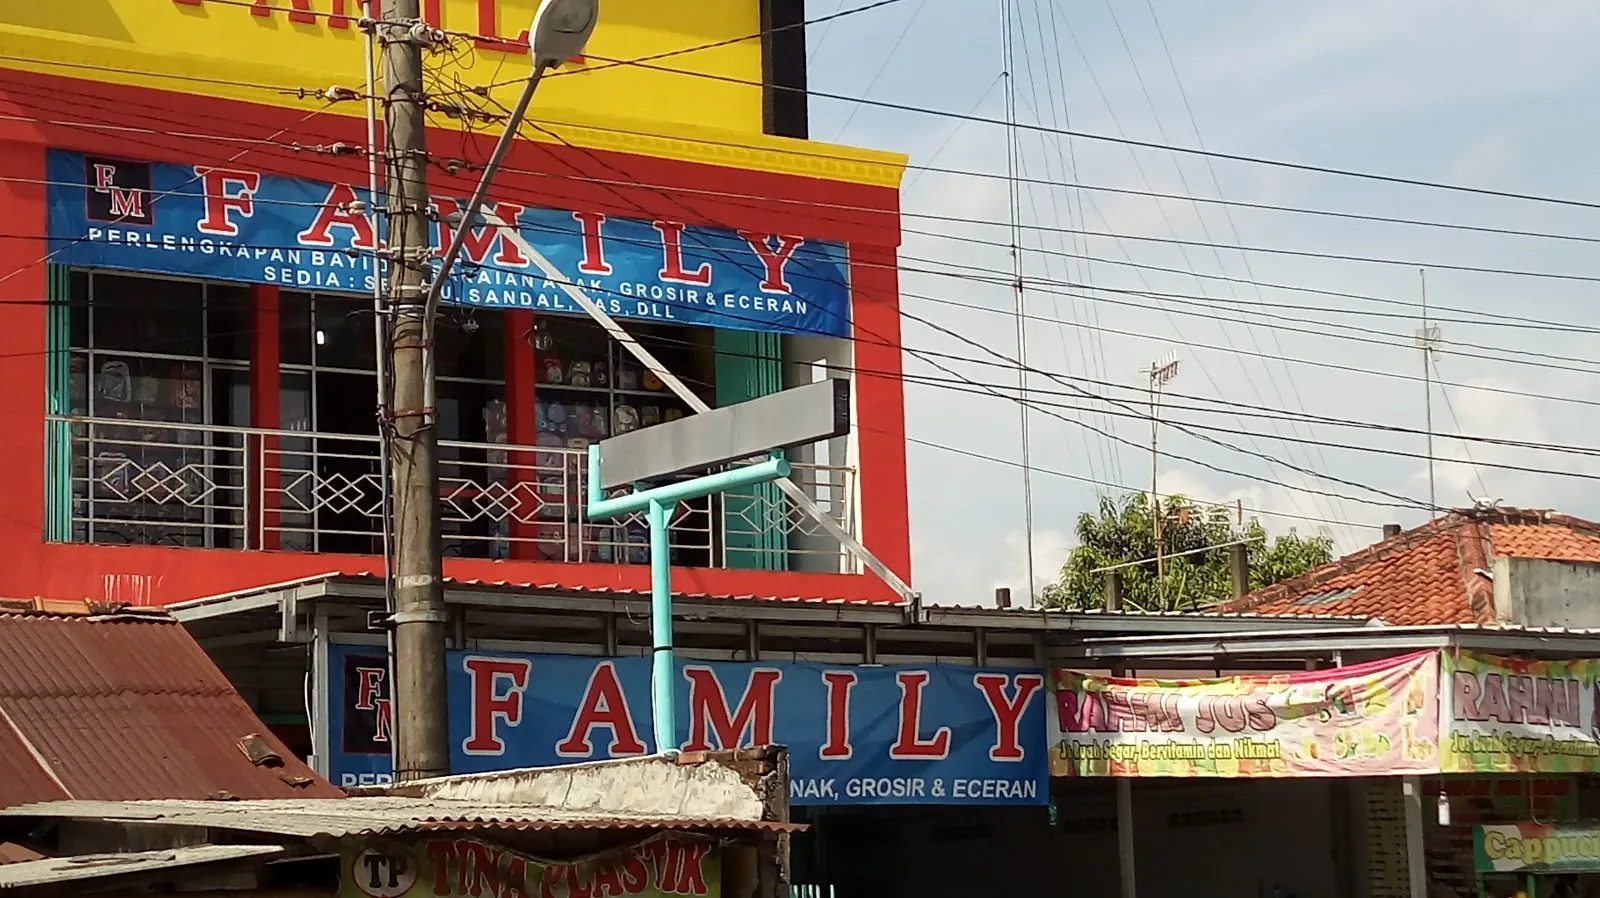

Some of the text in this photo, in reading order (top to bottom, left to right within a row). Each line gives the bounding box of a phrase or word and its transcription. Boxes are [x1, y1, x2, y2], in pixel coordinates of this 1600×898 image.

[193, 165, 804, 295] FAMILY
[89, 227, 301, 265] PERLENGKAPAN
[312, 250, 368, 270] BAYI
[542, 275, 612, 297] AAK,
[620, 283, 698, 304] GROSIR
[706, 292, 717, 306] &
[724, 294, 807, 315] ECERAN
[264, 267, 340, 287] SEDIA
[469, 288, 573, 311] SANDAL,
[588, 298, 629, 316] AS,
[637, 302, 675, 318] DLL
[462, 656, 1044, 763] FAMILY
[1196, 692, 1276, 733] JUS
[1141, 738, 1205, 760] Bervitamin
[1207, 737, 1232, 760] dan
[1234, 737, 1281, 760] Nikmat
[790, 778, 1036, 801] NAK, GROSIR & ECERAN
[364, 854, 408, 889] TP
